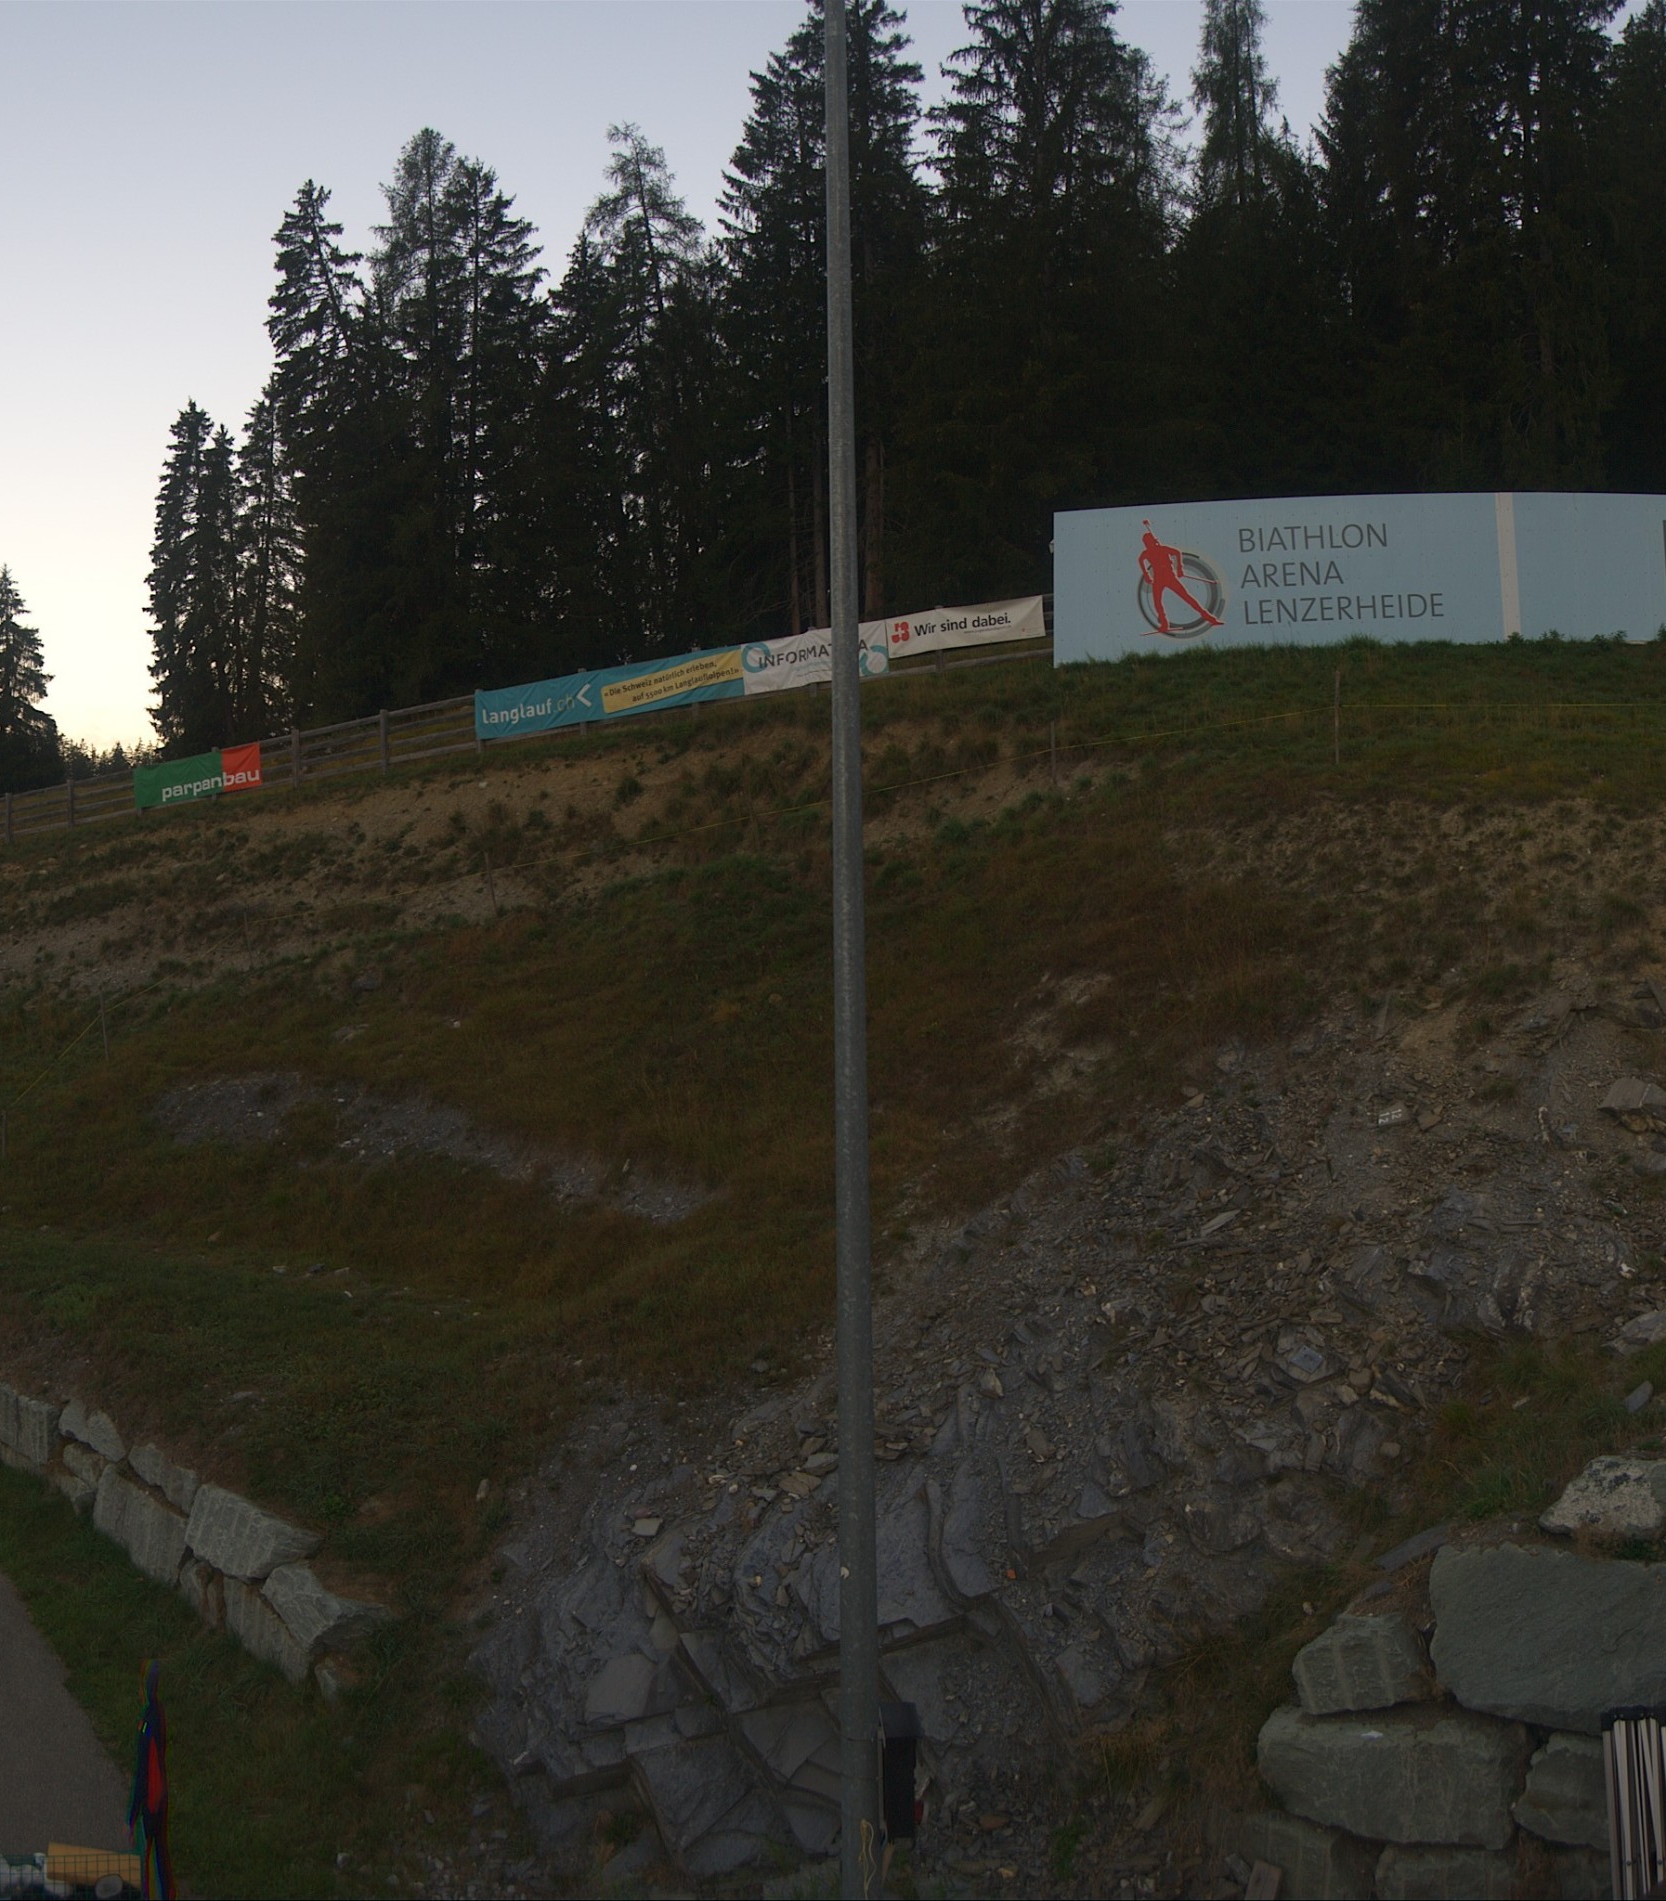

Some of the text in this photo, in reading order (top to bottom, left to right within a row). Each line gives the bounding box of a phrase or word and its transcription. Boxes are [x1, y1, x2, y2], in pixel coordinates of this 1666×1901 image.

[1238, 523, 1387, 552] BIATHLON
[1241, 560, 1344, 589] ARENA
[1244, 593, 1444, 625] LENZERHEIDE
[914, 623, 936, 636] Wir
[940, 618, 967, 632] sind
[972, 613, 1011, 629] dabei.
[622, 679, 652, 693] Schweiz
[161, 769, 260, 802] parpanbau
